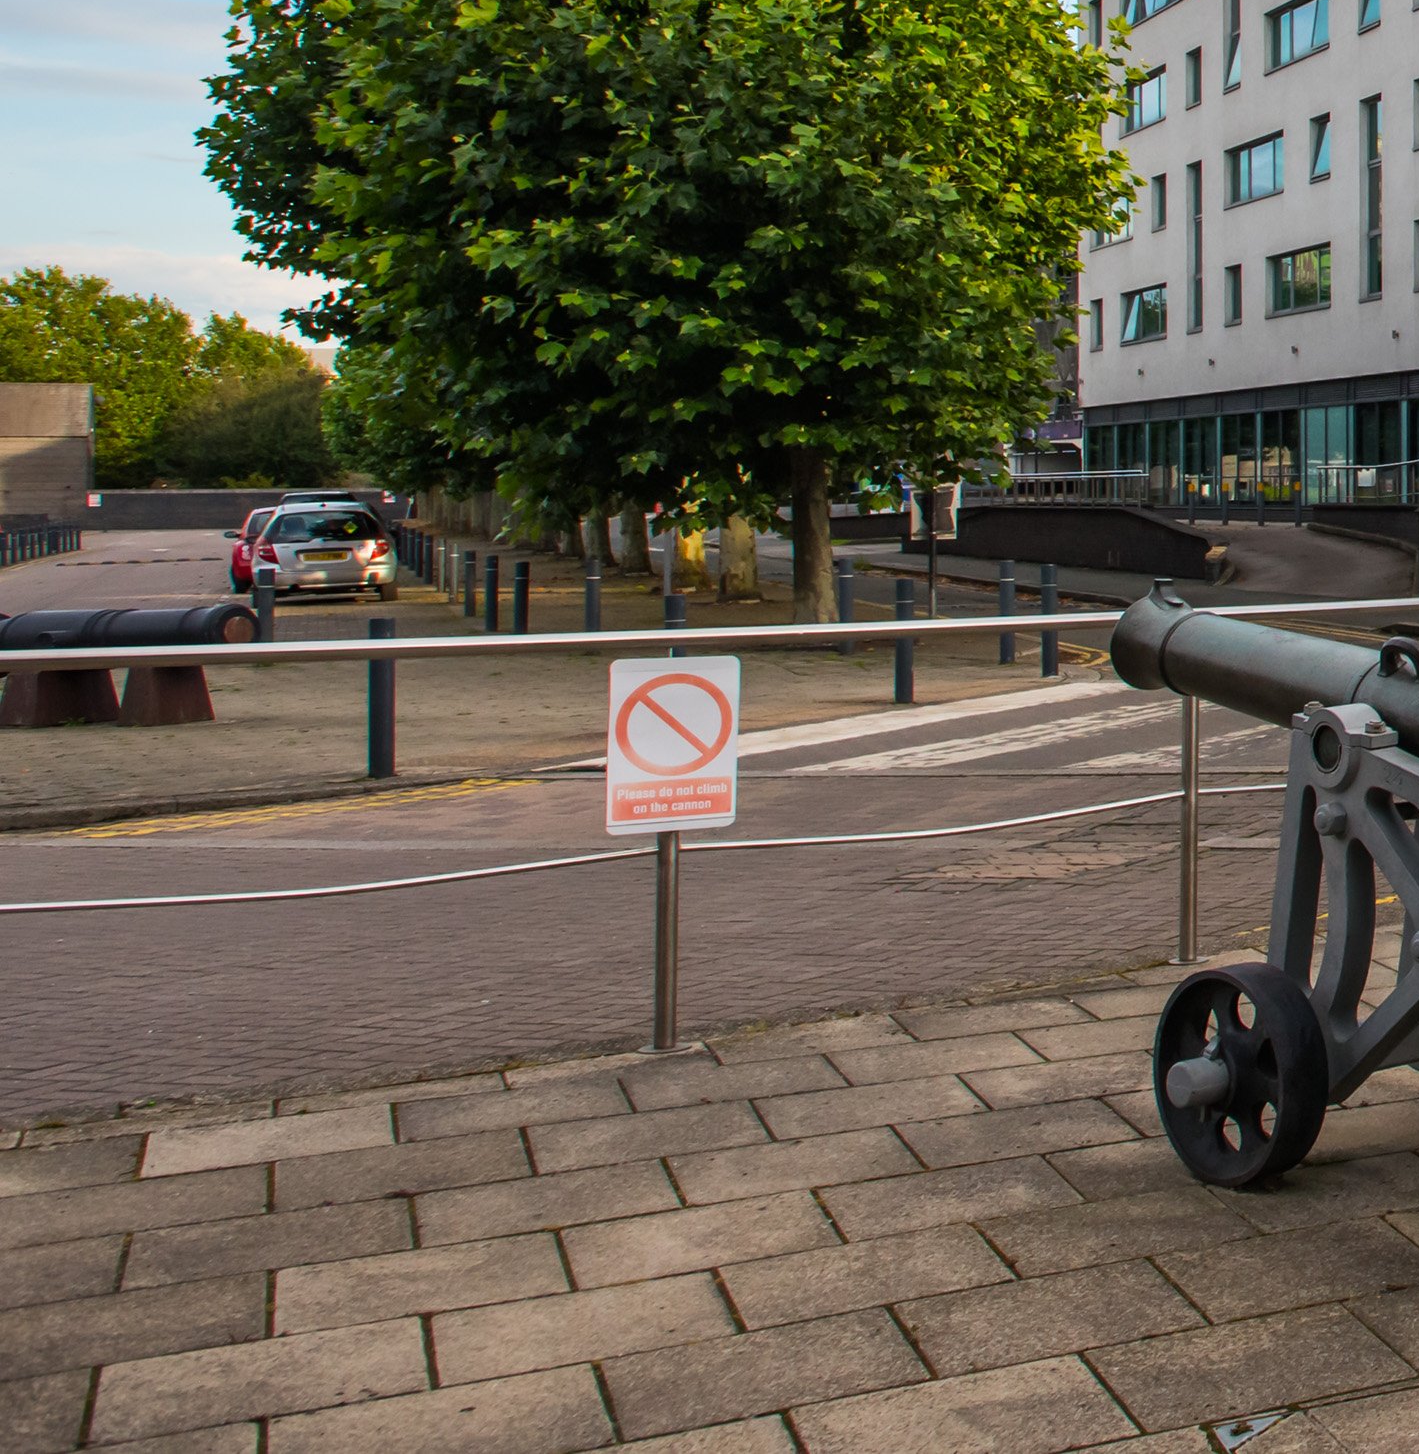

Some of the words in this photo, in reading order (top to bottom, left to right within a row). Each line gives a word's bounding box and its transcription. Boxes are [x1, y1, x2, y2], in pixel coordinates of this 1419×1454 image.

[617, 789, 655, 800] Please
[659, 786, 673, 797] do
[676, 785, 694, 796] not
[697, 782, 727, 794] climb
[633, 805, 647, 814] on
[651, 802, 668, 812] the
[671, 800, 712, 811] cannon
